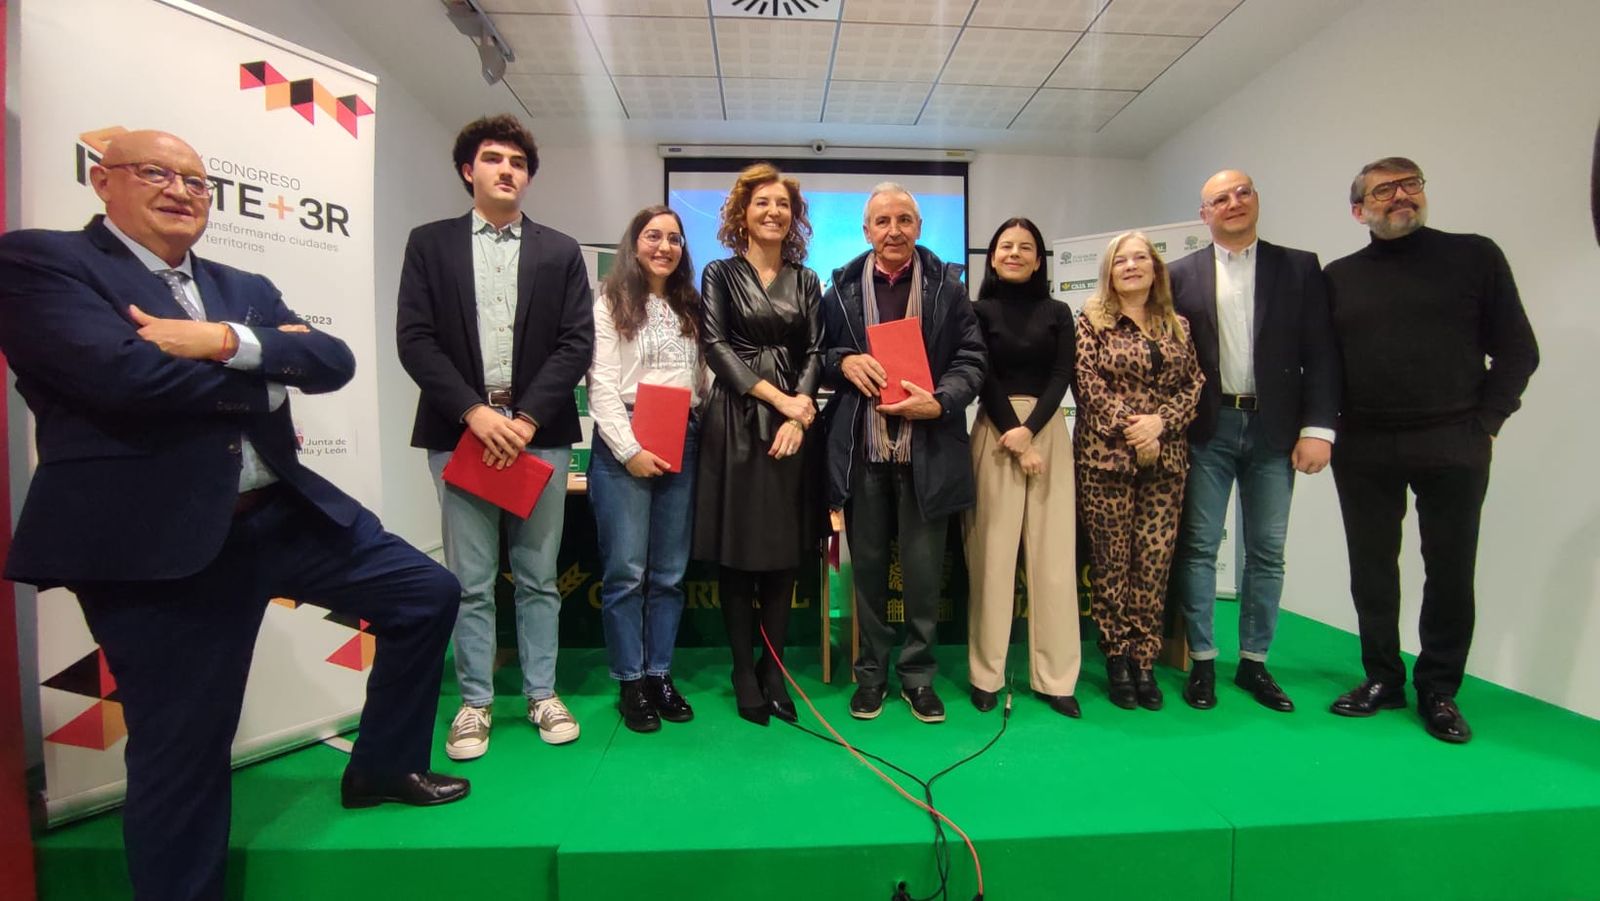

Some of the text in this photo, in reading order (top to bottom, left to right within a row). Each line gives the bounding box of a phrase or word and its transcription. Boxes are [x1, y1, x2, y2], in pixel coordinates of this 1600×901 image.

[209, 157, 300, 191] CONGRESO
[207, 174, 350, 237] TE+3R
[206, 220, 339, 252] ansformando ciudades
[206, 233, 265, 253] territorios
[305, 314, 332, 325] 2023
[306, 438, 347, 446] Junta de
[325, 446, 347, 455] León
